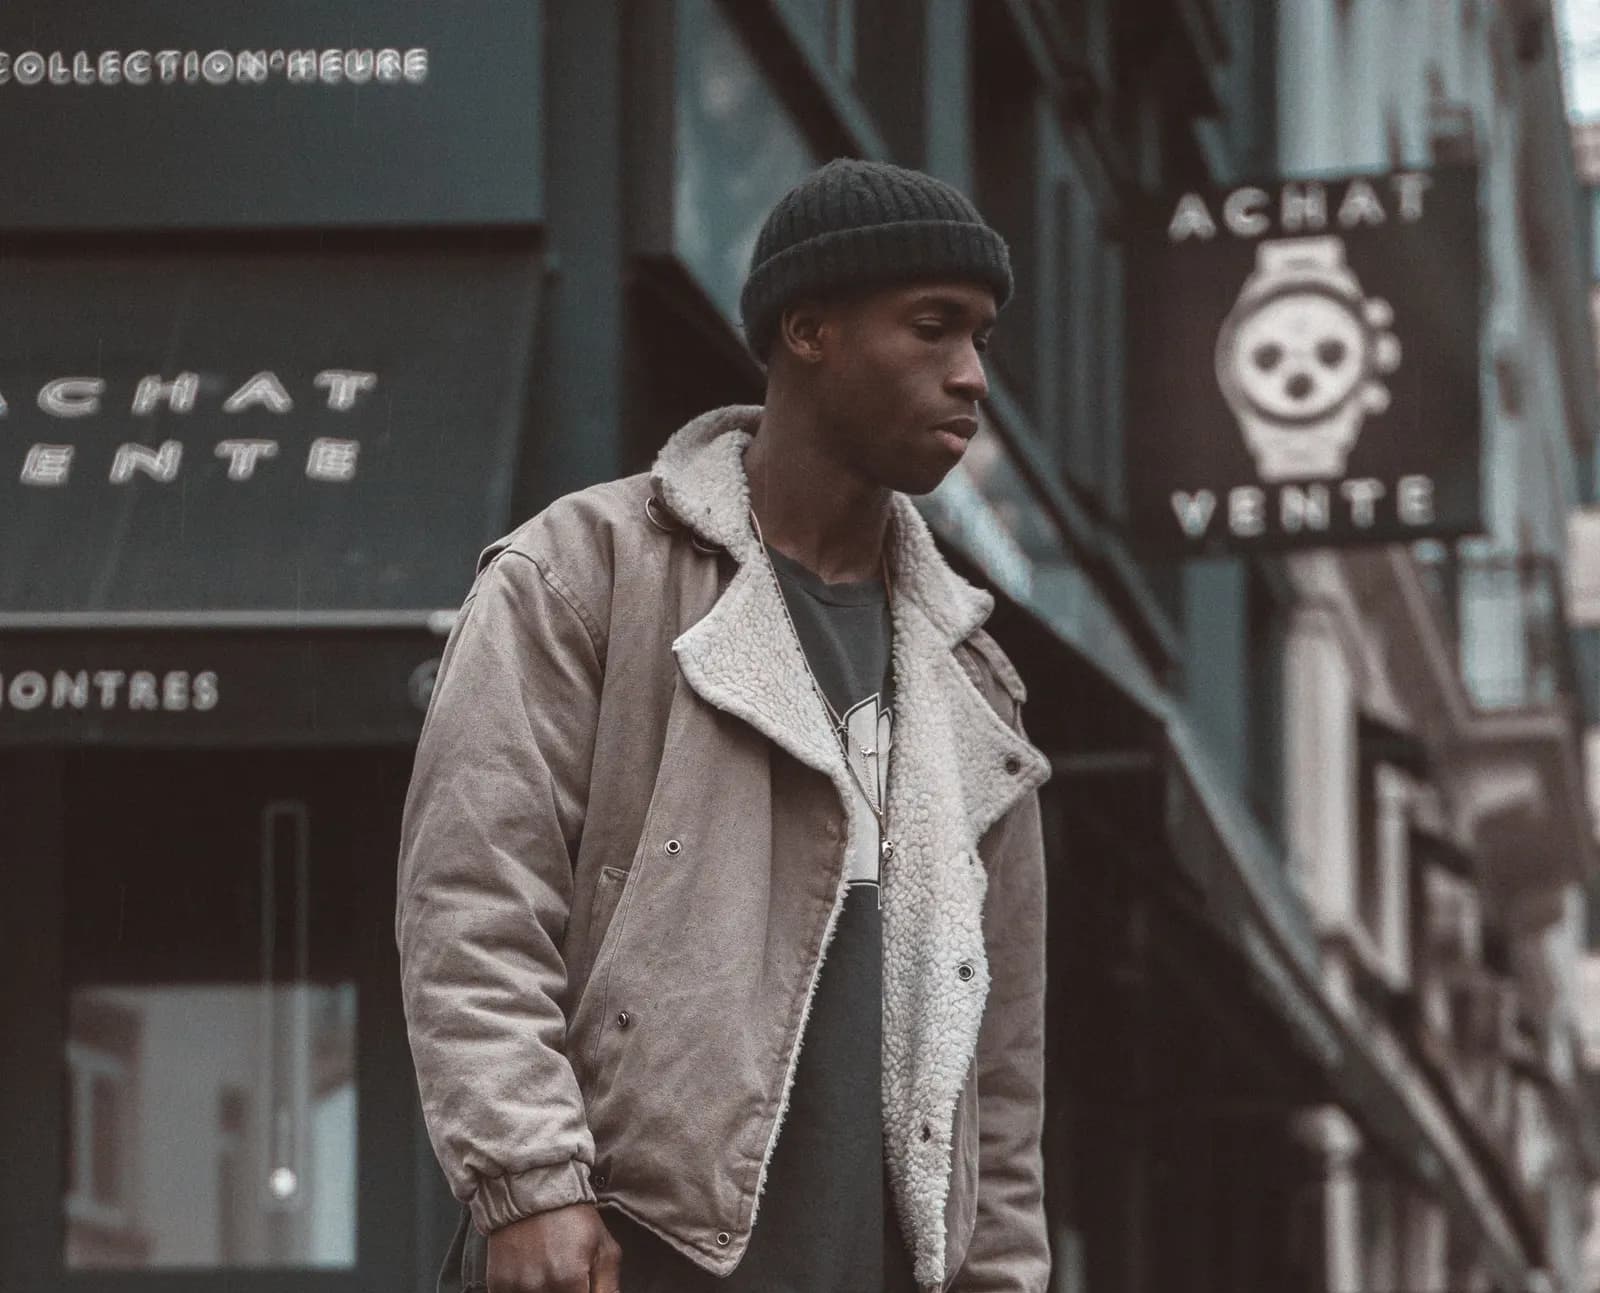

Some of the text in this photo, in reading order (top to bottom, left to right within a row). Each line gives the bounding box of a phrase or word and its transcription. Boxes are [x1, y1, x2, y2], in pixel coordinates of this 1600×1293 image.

[1168, 172, 1433, 241] ACHAT
[0, 370, 377, 417] CHAT
[20, 437, 360, 485] ENTE
[1170, 475, 1435, 538] VENTE
[0, 670, 218, 711] ONTRES
